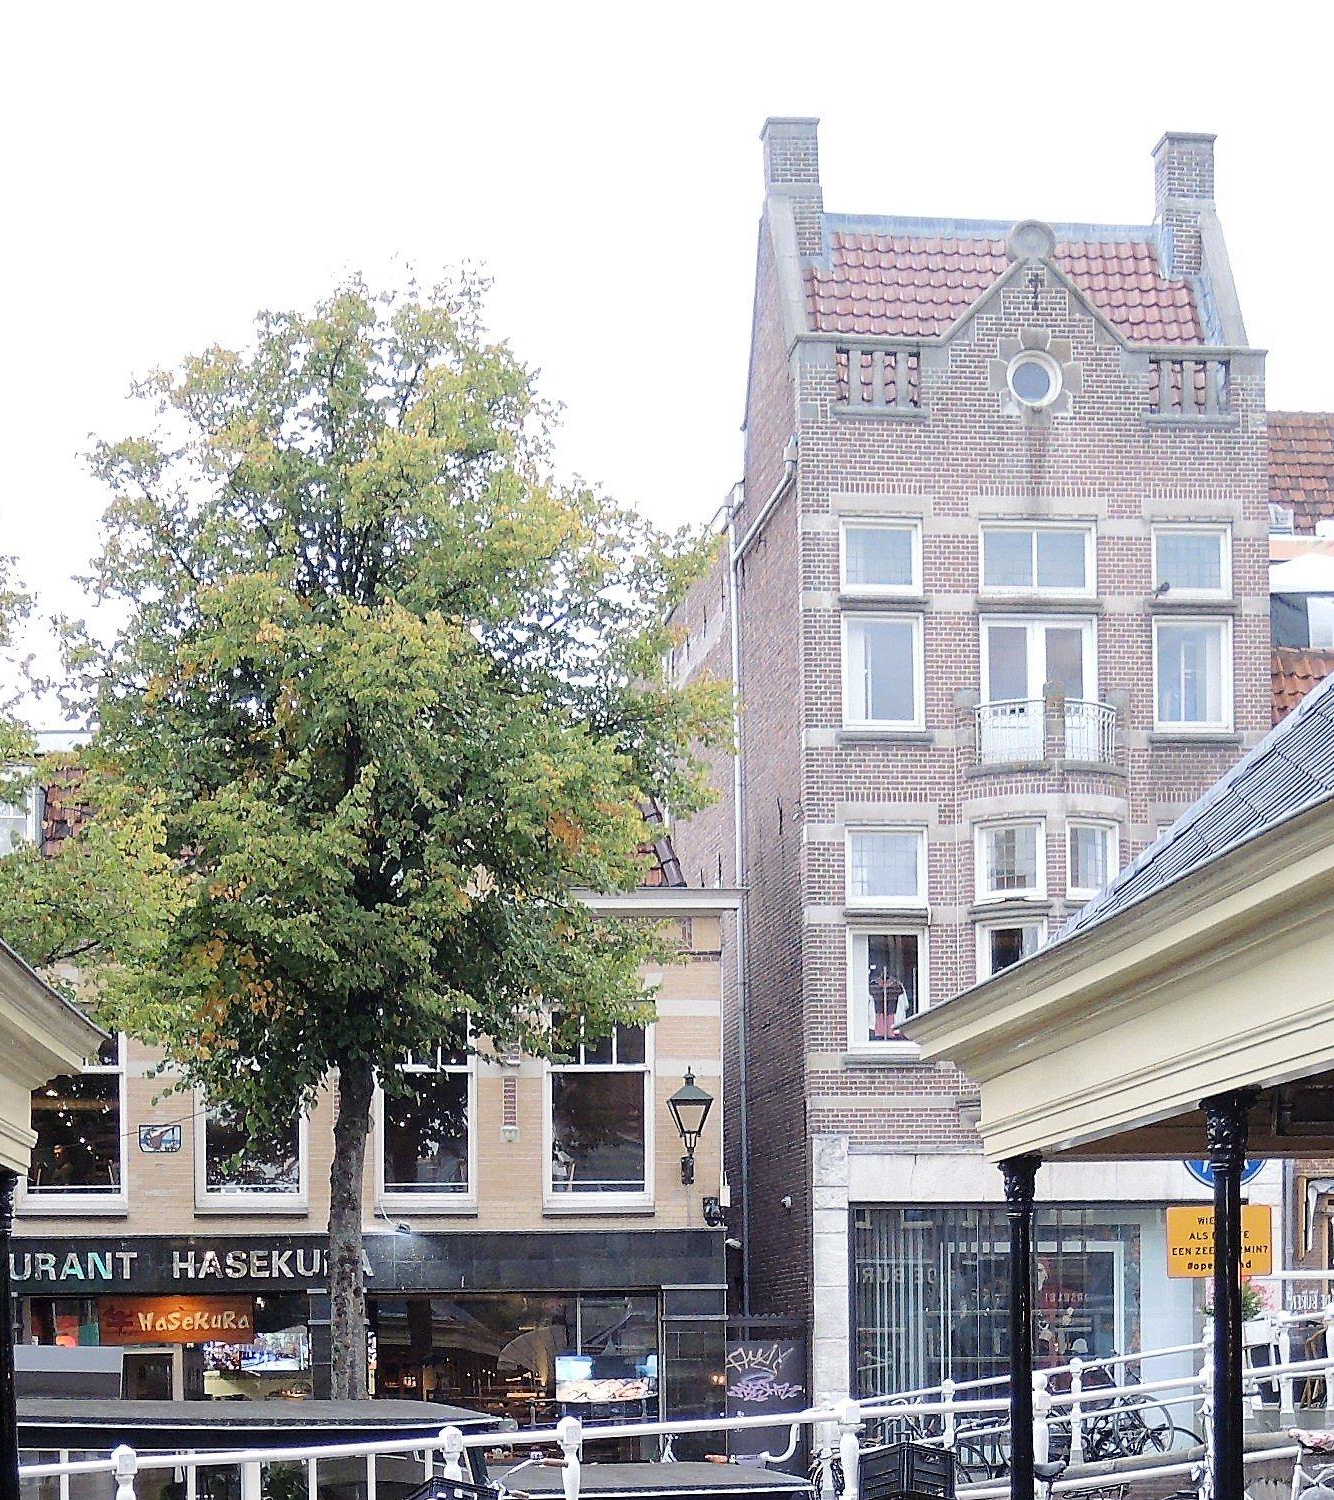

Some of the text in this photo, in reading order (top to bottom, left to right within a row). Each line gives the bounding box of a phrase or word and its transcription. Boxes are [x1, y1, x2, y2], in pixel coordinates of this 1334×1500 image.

[1189, 1232, 1208, 1241] ALS
[1172, 1247, 1192, 1256] EEN
[172, 1250, 375, 1279] HASEKUA
